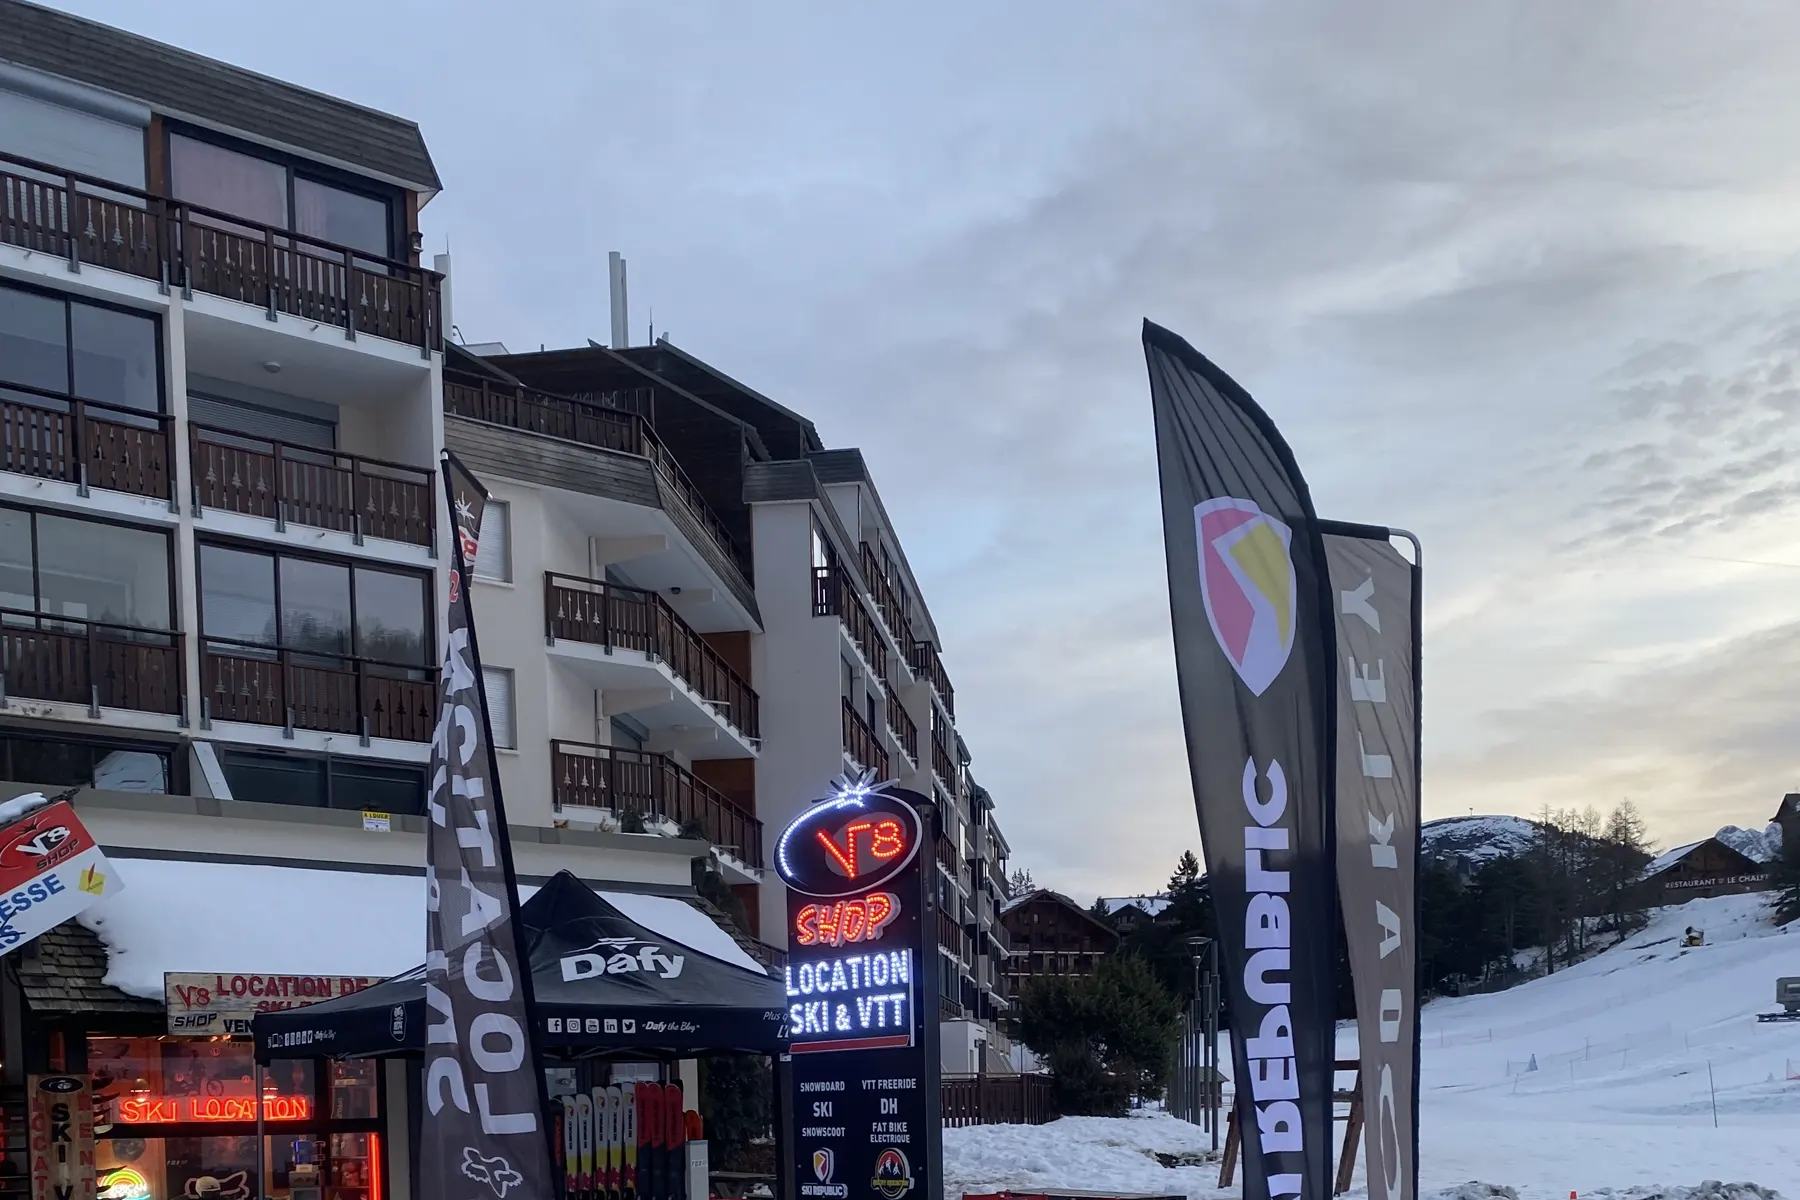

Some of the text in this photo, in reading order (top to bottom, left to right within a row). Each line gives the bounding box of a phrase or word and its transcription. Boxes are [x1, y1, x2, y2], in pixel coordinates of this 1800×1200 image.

[16, 826, 71, 856] V8
[817, 819, 904, 880] V8
[36, 838, 80, 870] SHOP
[1665, 873, 1769, 889] RESTAURANT LE CHALET
[796, 892, 896, 947] SHOP
[560, 946, 684, 982] Dafy
[785, 949, 910, 997] LOCATION
[175, 984, 211, 1008] V8
[216, 975, 331, 998] LOCATION
[173, 1012, 217, 1029] SHOP
[763, 1011, 781, 1021] Plus
[789, 992, 907, 1035] SKI & VTT
[800, 1080, 845, 1092] SNOWBOARD
[862, 1078, 917, 1091] VTT FREERIDE
[122, 1098, 178, 1122] SKI
[813, 1101, 833, 1118] SKI
[880, 1098, 898, 1115] DH
[51, 1102, 72, 1163] SKI
[802, 1127, 846, 1138] SNOWSCOOT
[872, 1121, 908, 1133] FAT BIKE
[870, 1133, 910, 1144] ELECTRIQUE
[801, 1185, 844, 1196] SKI REPUBLIC
